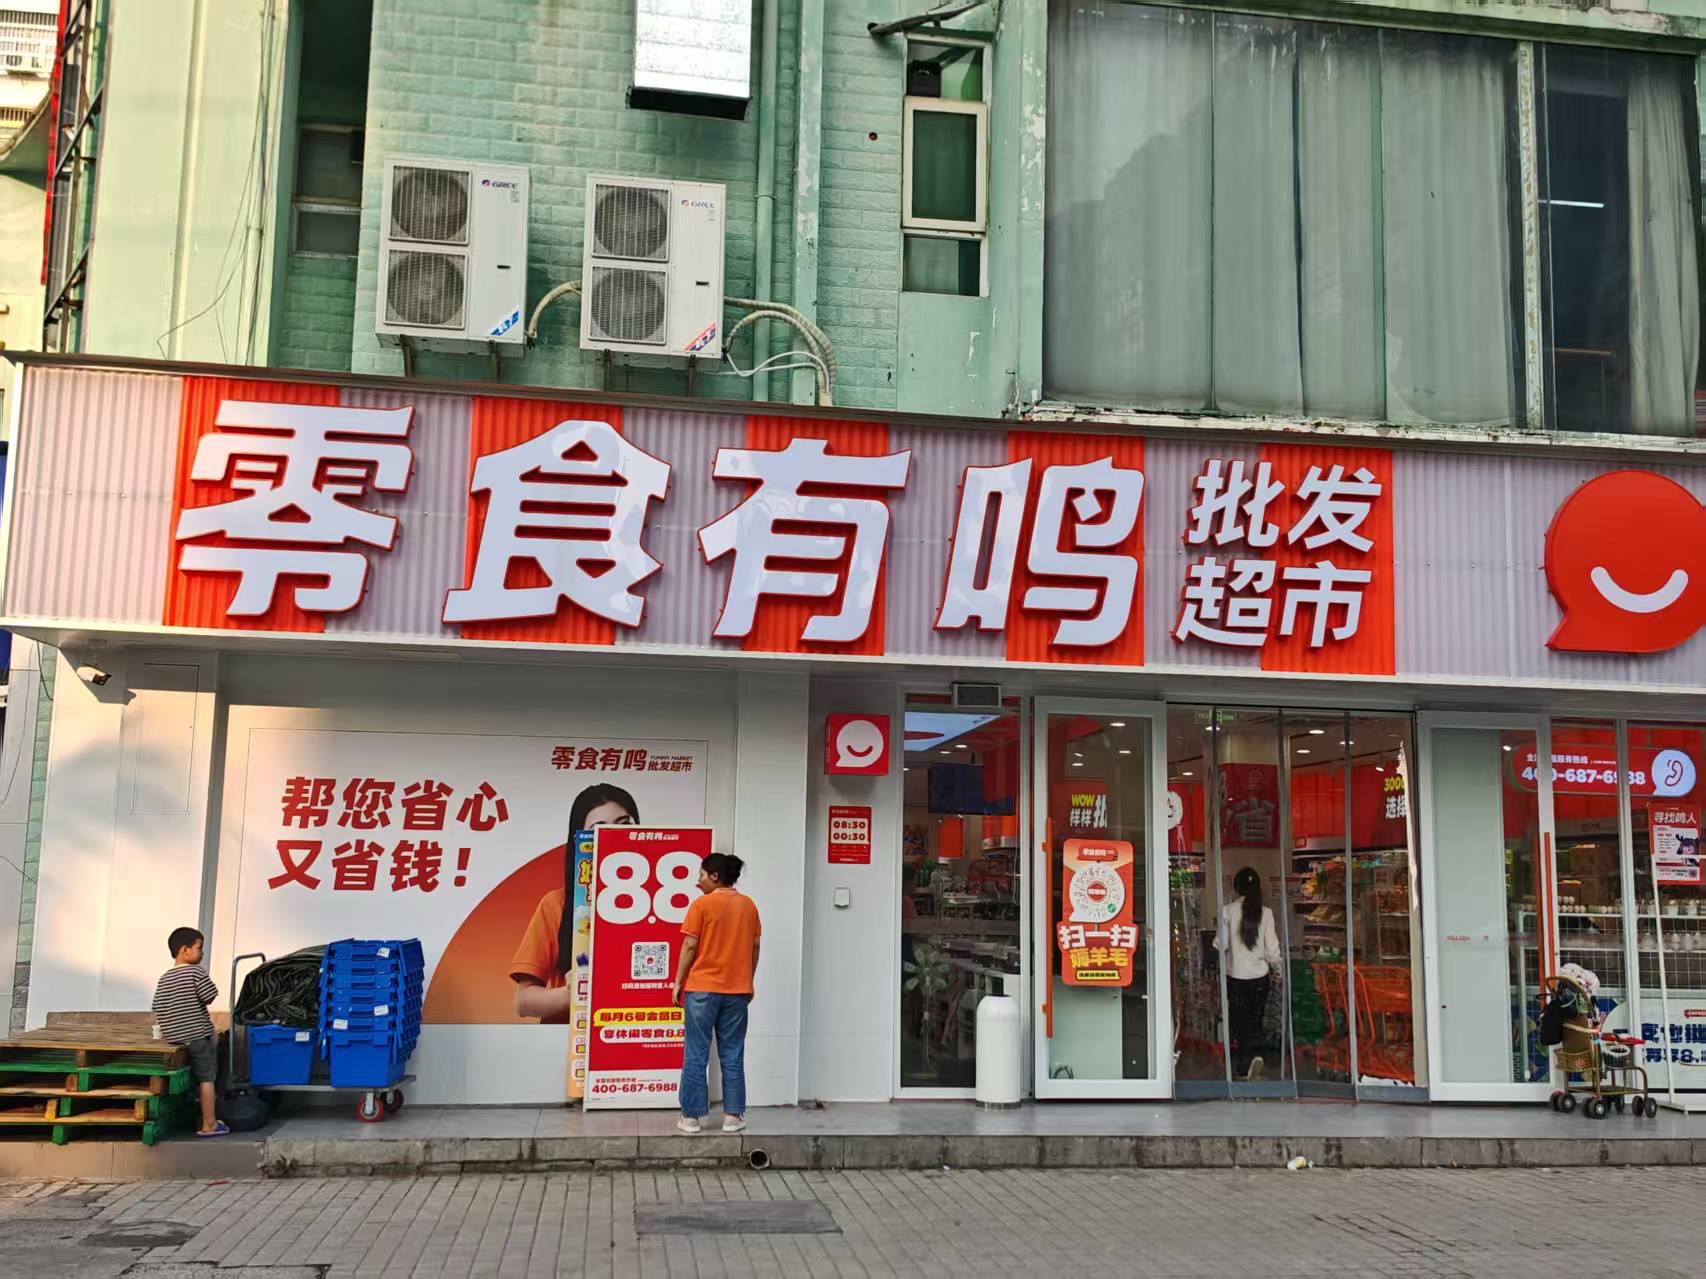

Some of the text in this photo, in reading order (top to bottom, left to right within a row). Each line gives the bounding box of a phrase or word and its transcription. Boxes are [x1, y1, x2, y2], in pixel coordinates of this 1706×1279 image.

[1186, 458, 1383, 554] 批发
[175, 399, 1145, 648] 零食有鸣
[1174, 557, 1373, 649] 超市
[551, 746, 648, 771] 零食有鸣
[647, 761, 693, 772] 批发超市
[281, 776, 509, 832] 帮您省心
[1071, 793, 1095, 807] WOW
[833, 821, 866, 829] 08:30
[833, 833, 866, 841] 00:30
[268, 839, 472, 892] 又省钱！
[596, 851, 706, 925] 8.8
[1058, 924, 1137, 950] 扫一扫
[592, 1083, 678, 1094] 400-687-6988
